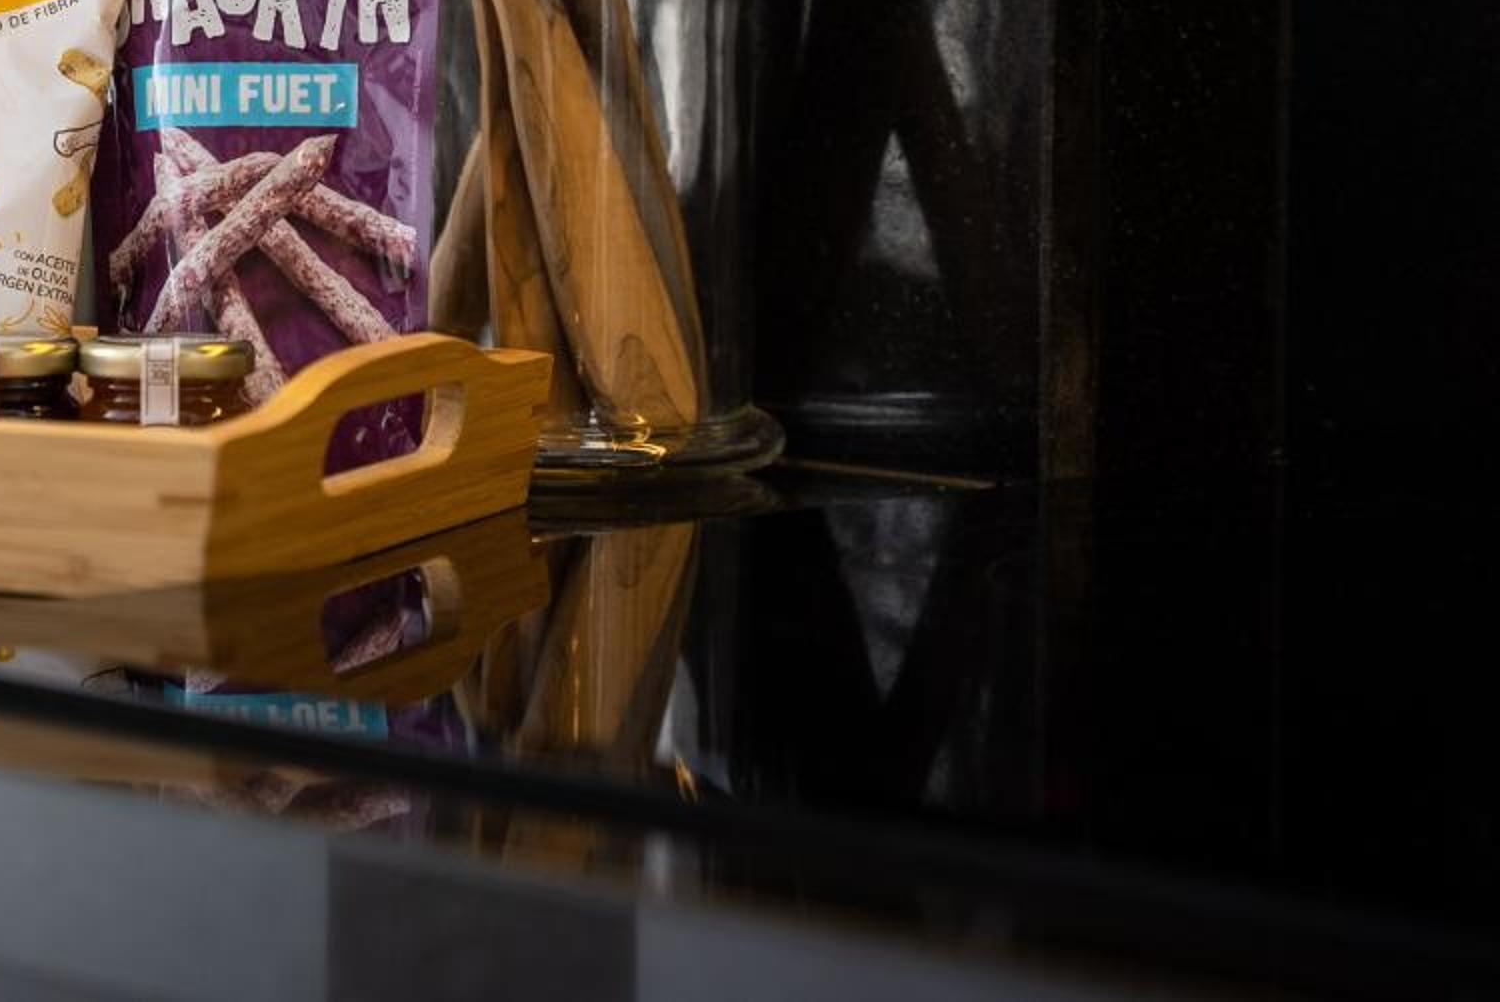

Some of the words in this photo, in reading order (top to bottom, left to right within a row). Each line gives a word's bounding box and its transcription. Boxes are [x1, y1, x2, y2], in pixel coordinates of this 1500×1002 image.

[9, 12, 30, 29] DE
[238, 73, 338, 114] FUET
[32, 267, 70, 289] OLIVA
